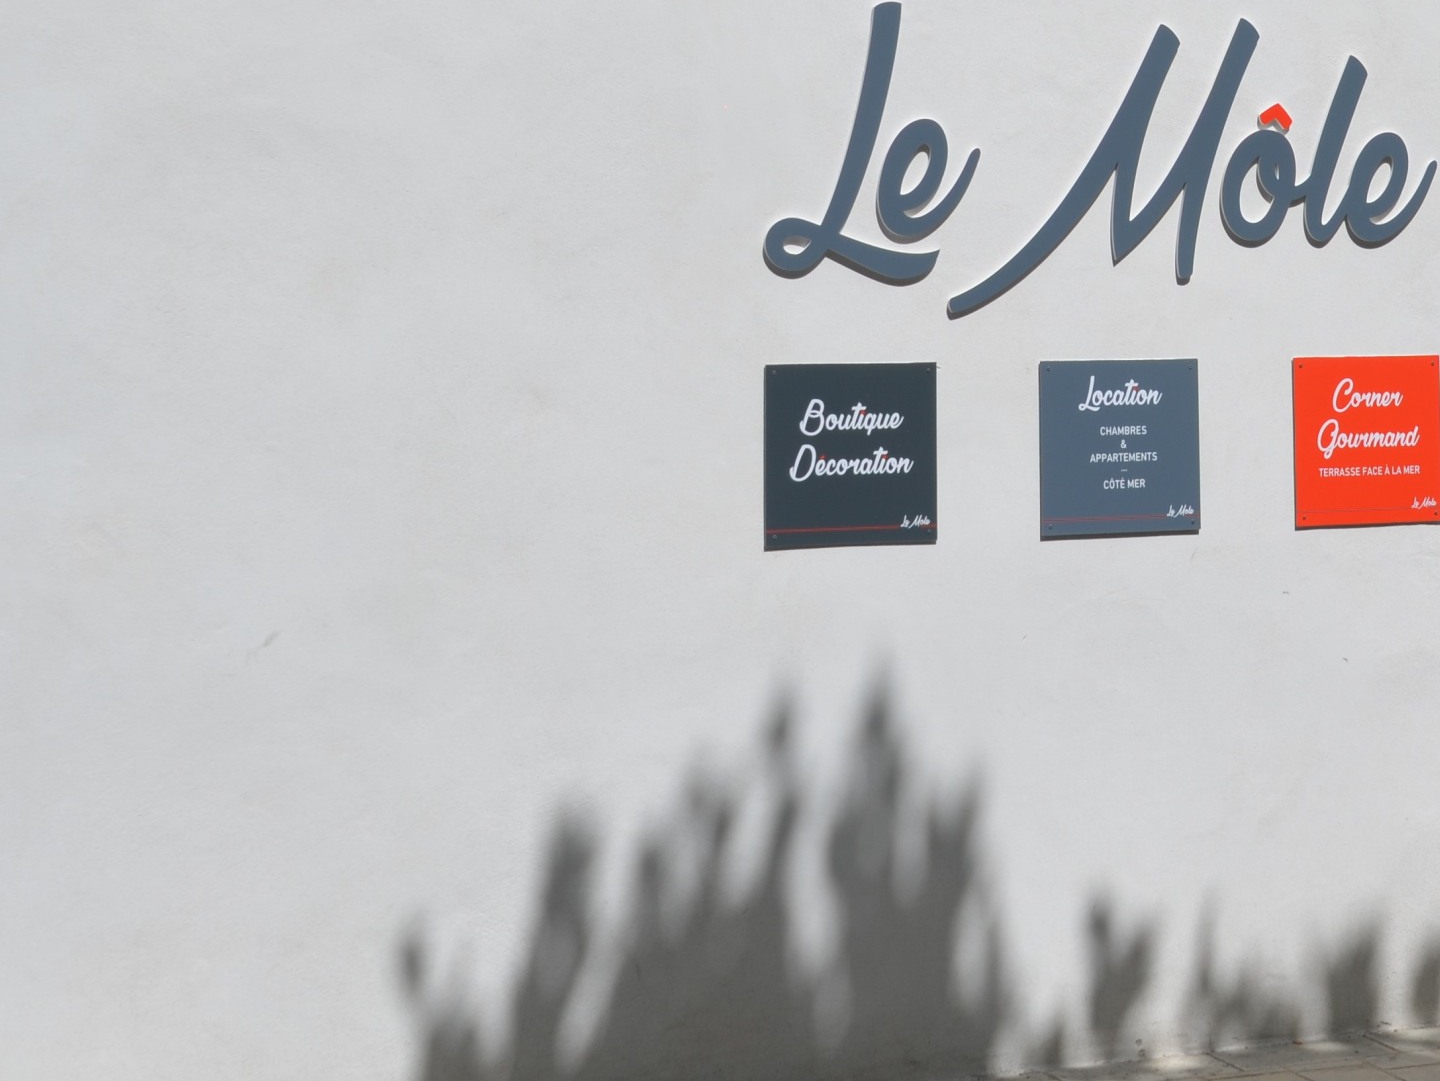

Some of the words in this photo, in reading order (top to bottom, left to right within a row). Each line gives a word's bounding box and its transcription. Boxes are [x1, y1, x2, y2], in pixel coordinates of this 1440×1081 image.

[763, 1, 981, 285] Le
[946, 17, 1437, 319] Môle
[1078, 375, 1162, 411] Location
[1333, 378, 1403, 413] Corner
[799, 398, 904, 436] Boutique
[1100, 425, 1147, 436] CHAMBRES
[1120, 439, 1127, 449] &
[1317, 418, 1420, 459] Gourmand
[789, 444, 914, 482] Décoration
[1090, 452, 1158, 463] APPARTEMENTS
[1319, 467, 1361, 477] TERRASSE
[1362, 466, 1382, 476] FACE
[1384, 464, 1390, 475] À
[1391, 465, 1401, 475] LA
[1403, 465, 1420, 475] MER
[1103, 478, 1125, 489] CÔTÉ
[1127, 479, 1145, 488] MER
